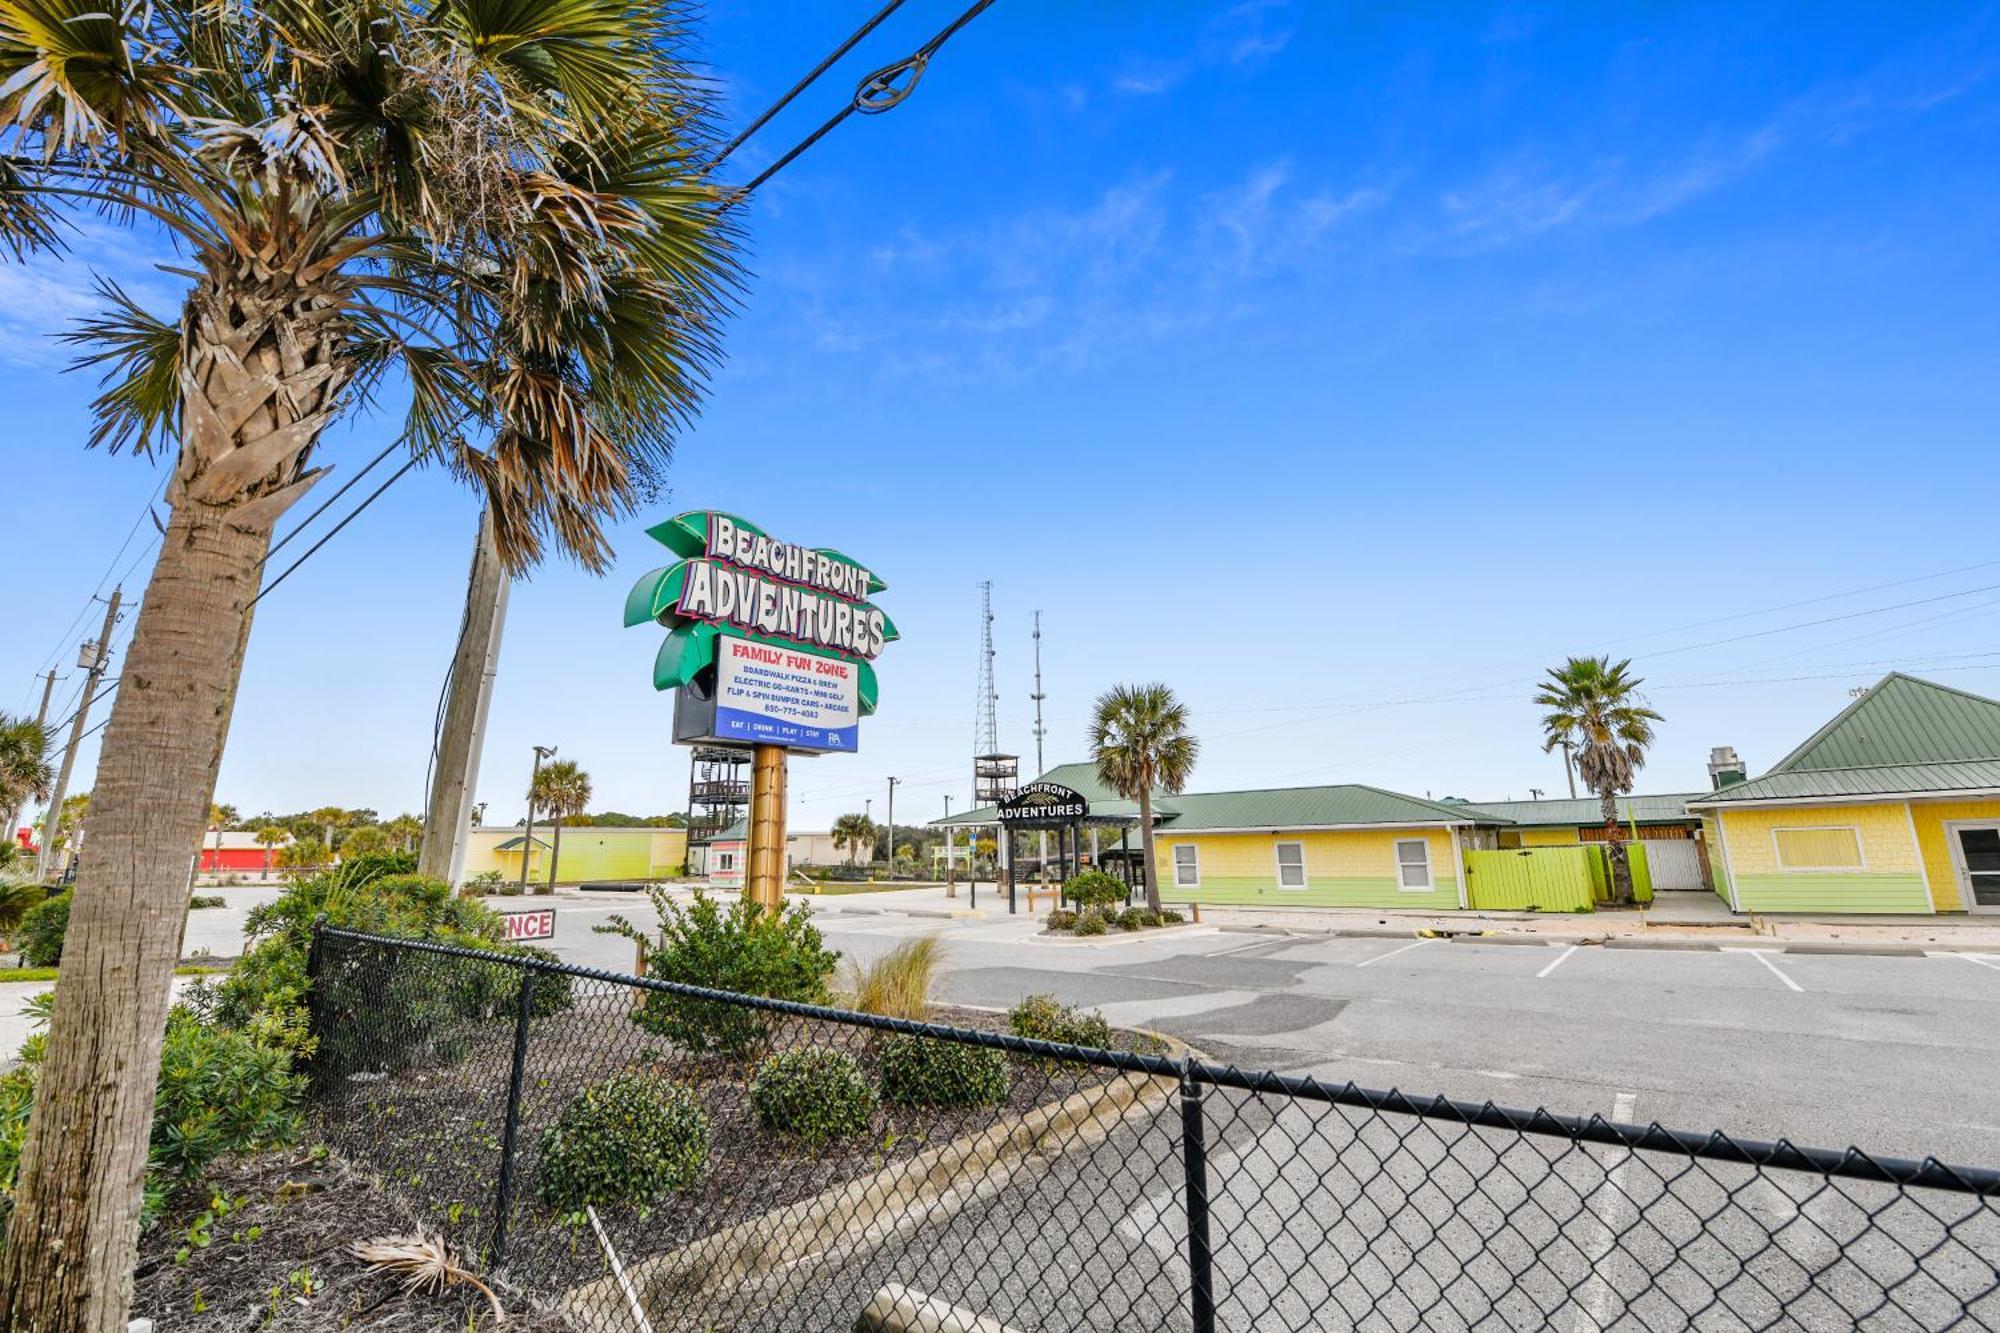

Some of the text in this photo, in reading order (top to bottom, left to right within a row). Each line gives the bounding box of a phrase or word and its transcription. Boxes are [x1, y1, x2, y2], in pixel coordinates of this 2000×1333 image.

[712, 516, 870, 601] BEACHFRONT
[685, 562, 885, 657] ADVENTURES
[733, 644, 847, 679] FAMILY FUN ZONE
[734, 676, 771, 689] ELECTRIC
[743, 665, 790, 681] BOARDWALK
[791, 674, 812, 684] PIZZA
[819, 680, 838, 689] BREW
[727, 687, 744, 696] FLIP
[753, 691, 770, 701] SPIN
[771, 694, 800, 705] BUMPER
[801, 699, 819, 708] CARS
[731, 720, 744, 729] EAT
[782, 728, 798, 736] PLAY
[1003, 783, 1073, 803] BEACHFRONT
[997, 803, 1084, 819] ADVENTURES
